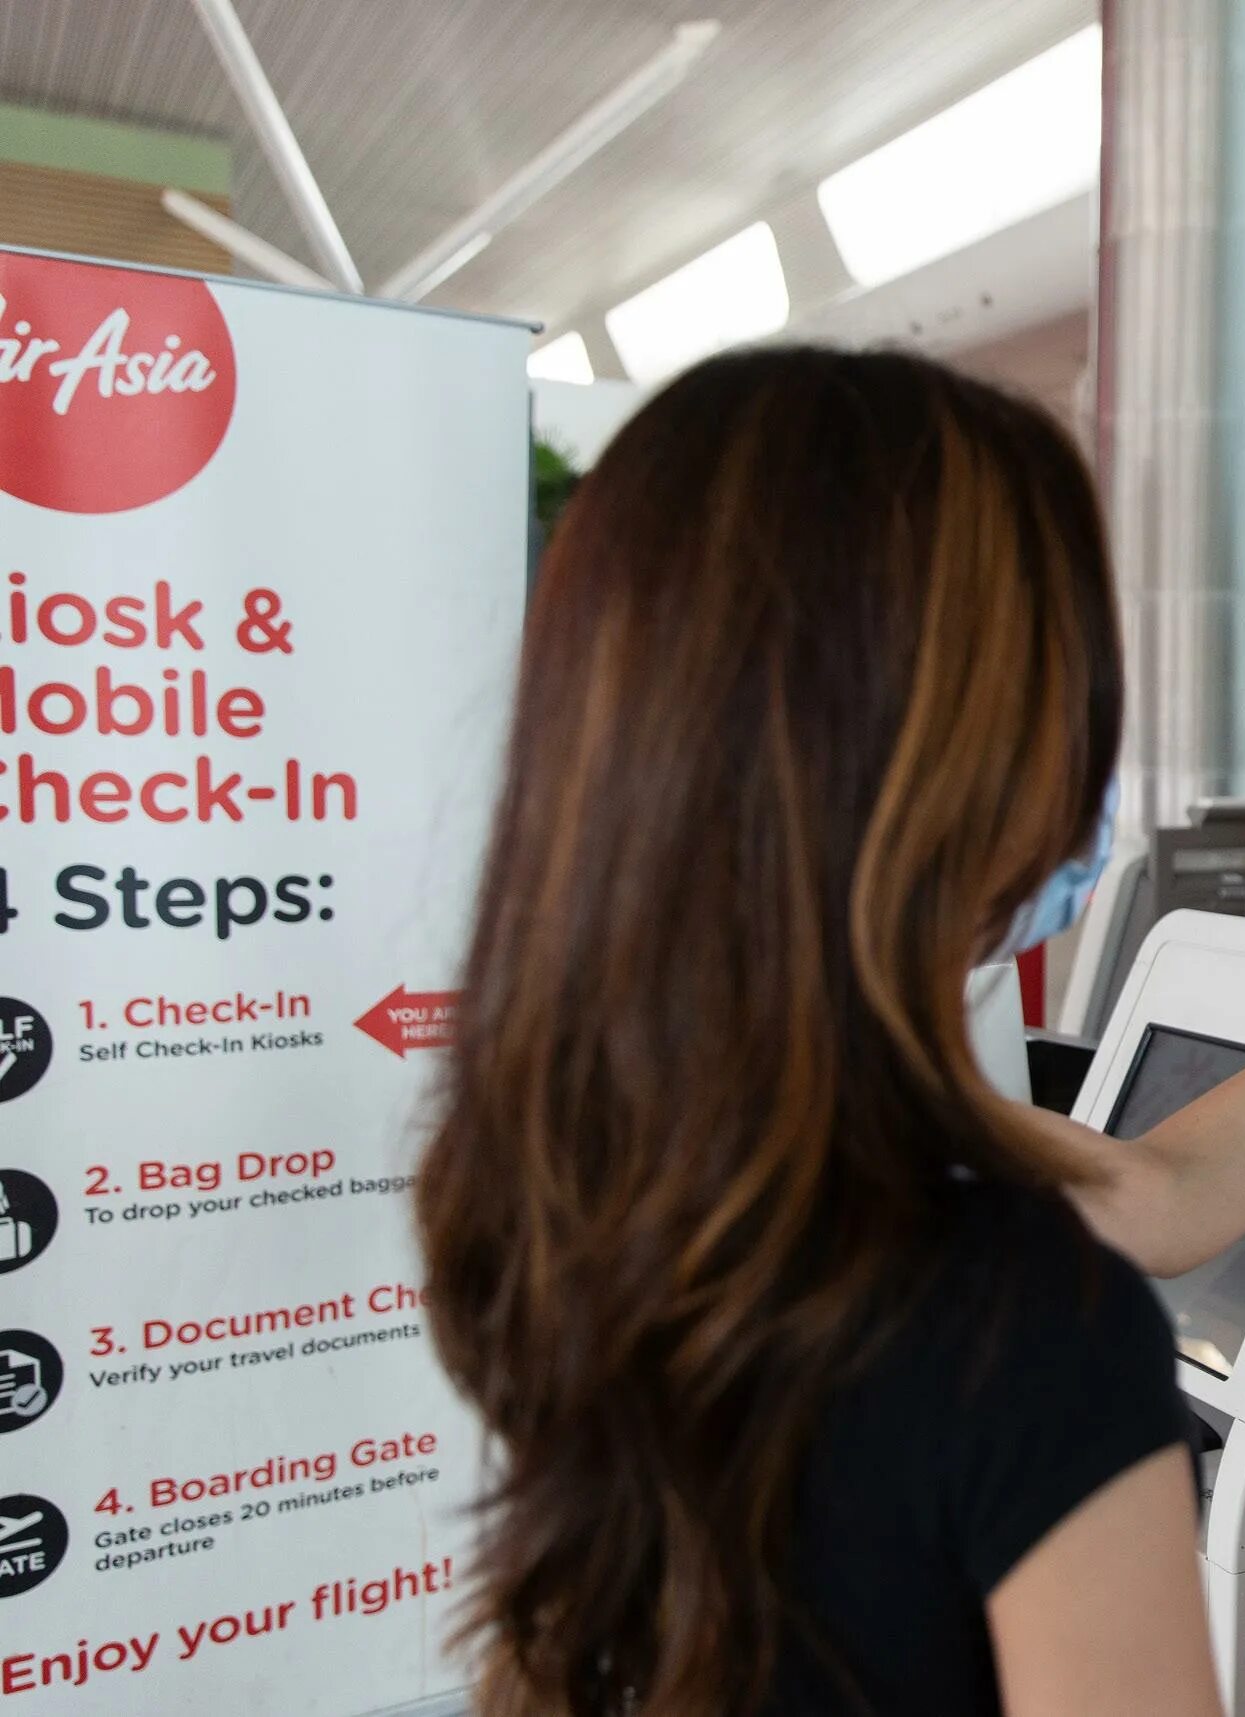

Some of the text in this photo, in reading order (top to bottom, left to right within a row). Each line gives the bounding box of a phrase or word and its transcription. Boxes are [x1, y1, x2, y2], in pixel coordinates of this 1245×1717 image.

[0, 571, 294, 654] iosk &
[54, 863, 334, 940] Steps:
[78, 990, 312, 1030] 1. Check-In
[386, 1007, 428, 1024] YOU
[78, 1029, 324, 1062] Self Check-In Kiosks
[84, 1148, 336, 1197] 2. Bag Drop
[85, 1174, 418, 1225] To drop your checked bagga
[89, 1282, 430, 1358] 3. Document Che
[89, 1322, 422, 1389] Verify your travel documents
[93, 1431, 438, 1517] 4. Boarding Gate
[94, 1465, 441, 1550] Gate closes 20 minutes before
[94, 1533, 216, 1574] departure
[1, 1556, 454, 1696] Enjoy your flight!
